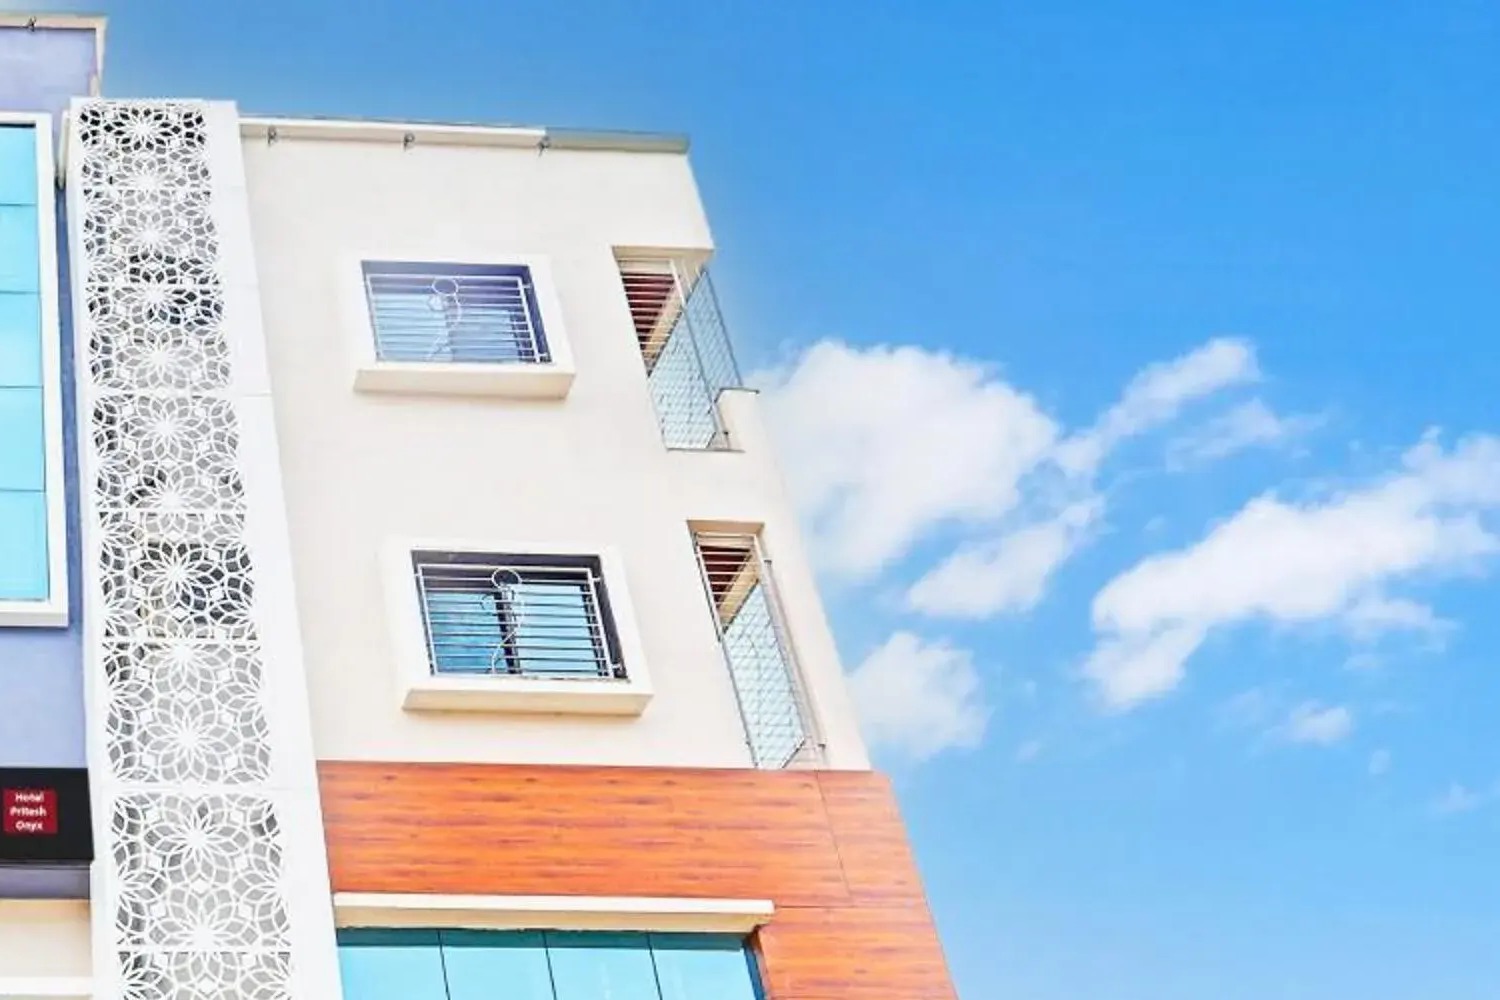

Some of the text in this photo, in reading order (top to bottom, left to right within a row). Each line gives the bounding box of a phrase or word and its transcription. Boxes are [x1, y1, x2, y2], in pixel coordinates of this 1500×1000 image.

[15, 791, 44, 802] Hotel
[10, 805, 47, 817] Pritesh
[15, 820, 43, 832] Onyx
